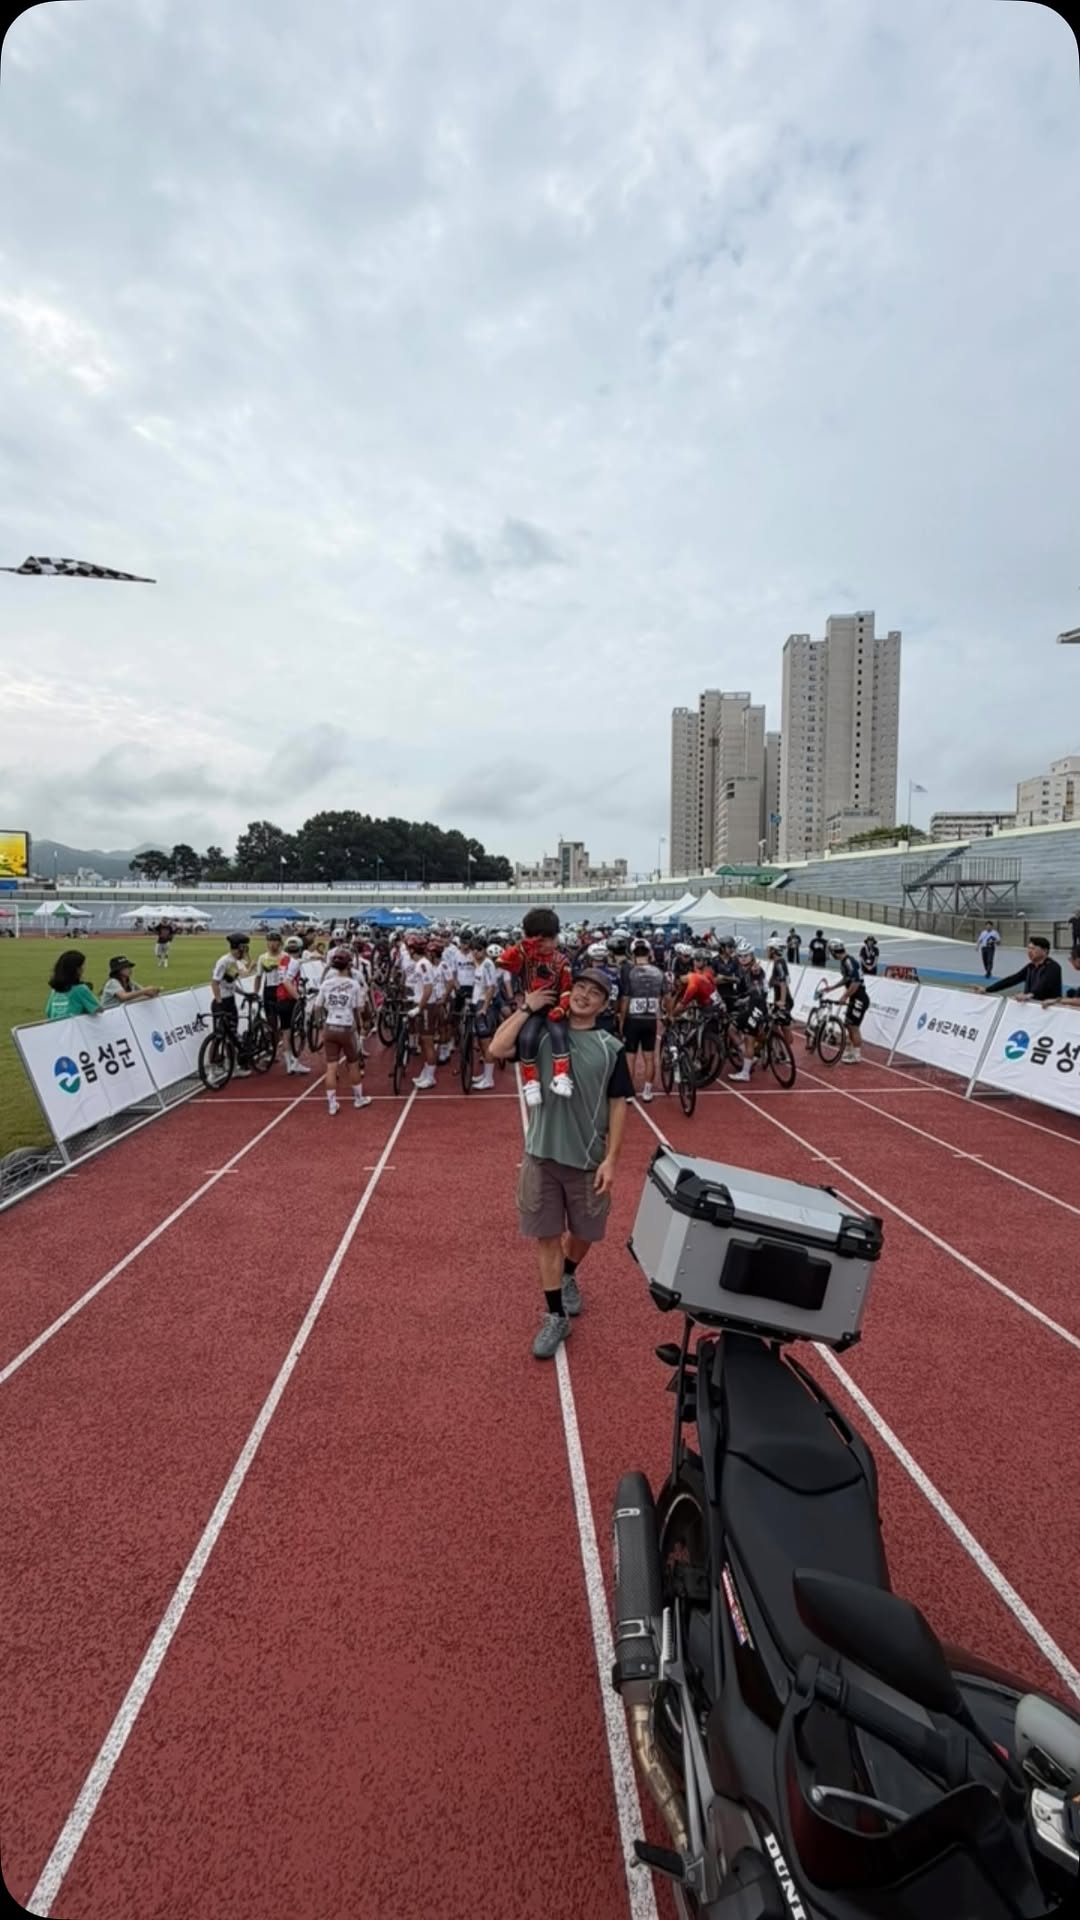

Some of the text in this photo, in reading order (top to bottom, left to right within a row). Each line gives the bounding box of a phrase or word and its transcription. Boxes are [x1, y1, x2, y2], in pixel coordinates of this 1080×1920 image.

[927, 1017, 979, 1041] 음성군체육회
[79, 1037, 136, 1084] 음성군
[1030, 1036, 1080, 1073] 음성
